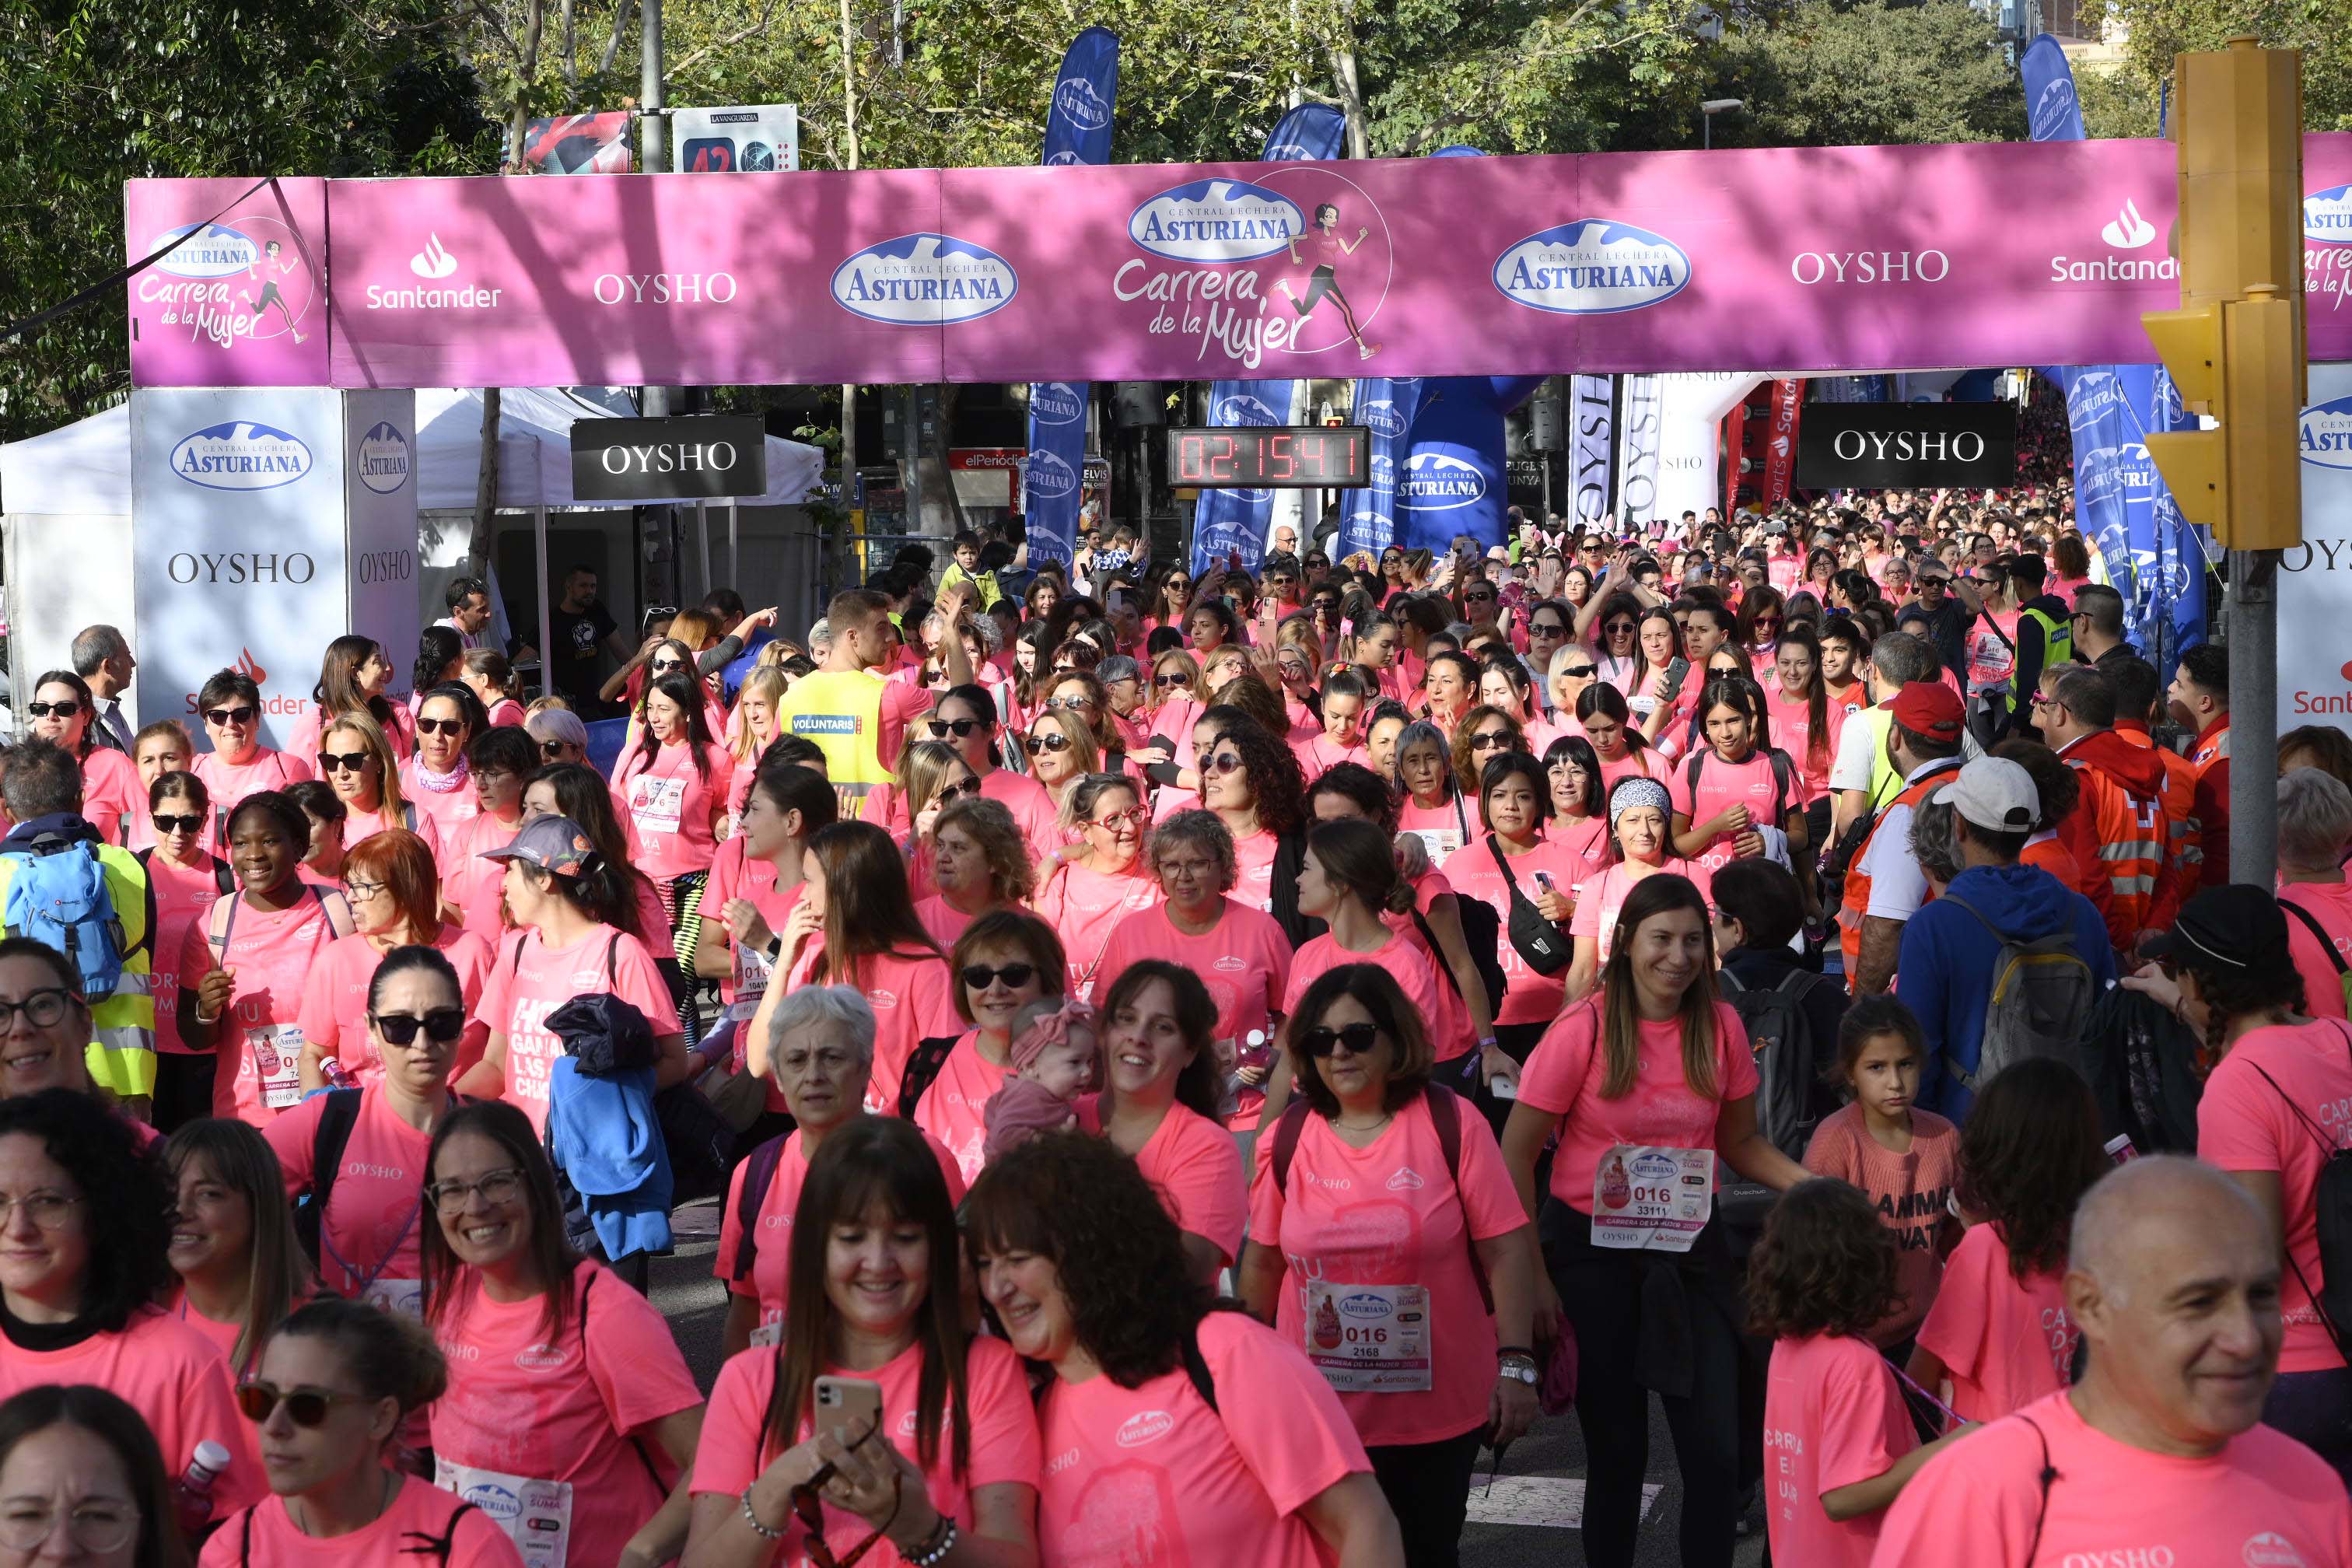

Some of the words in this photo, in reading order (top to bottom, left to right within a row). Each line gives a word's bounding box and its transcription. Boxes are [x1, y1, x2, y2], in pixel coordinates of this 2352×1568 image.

[1142, 210, 1290, 242] ASTURIANA
[1538, 253, 1599, 262] CENTRAL
[1606, 250, 1668, 260] LECHERA
[874, 265, 931, 275] CENTRAL
[940, 264, 996, 273] LECHERA
[1507, 256, 1675, 290] ASTURIANA
[1791, 250, 1948, 284] OYSHO
[2051, 256, 2180, 282] Santand
[138, 275, 229, 303] Carrera
[594, 272, 737, 304] OYSHO
[845, 268, 1003, 301] ASTURIANA
[1114, 259, 1258, 302] Carrera
[2323, 272, 2336, 292] la
[367, 285, 501, 309] Santander
[161, 306, 177, 324] de
[182, 304, 193, 324] la
[192, 300, 265, 348] Mujer
[1150, 305, 1175, 334] de
[1182, 303, 1202, 334] la
[1197, 295, 1312, 369] Mujer
[1834, 430, 1984, 461] OYSHO
[181, 447, 301, 473] ASTURIANA
[362, 448, 407, 475] ASTURIANA
[602, 442, 736, 474] OYSHO
[1181, 436, 1354, 479] 02:15:41
[1083, 470, 1107, 479] ELVIS
[168, 553, 314, 583] OYSHO
[359, 550, 411, 583] OYSHO
[793, 719, 854, 730] VOLUNTARIS
[745, 966, 770, 978] 016
[1216, 961, 1243, 969] ASTURIANA
[264, 1081, 291, 1090] CARRERA
[263, 1093, 292, 1103] OYSHO
[349, 1163, 403, 1180] OYSHO
[1633, 1163, 1674, 1174] ASTURIANA
[1634, 1187, 1671, 1202] 016
[1637, 1206, 1667, 1216] 33111
[1602, 1231, 1638, 1242] OYSHO
[1287, 1254, 1322, 1280] TU
[1343, 1303, 1391, 1314] ASTURIANA
[1346, 1328, 1387, 1343] 016
[1321, 1358, 1353, 1367] CARRERA
[1353, 1348, 1379, 1357] 2168
[1383, 1374, 1421, 1384] Santander
[1122, 1419, 1170, 1444] ASTURIANA
[467, 1493, 518, 1514] ASTURIANA
[530, 1498, 560, 1509] SUMA
